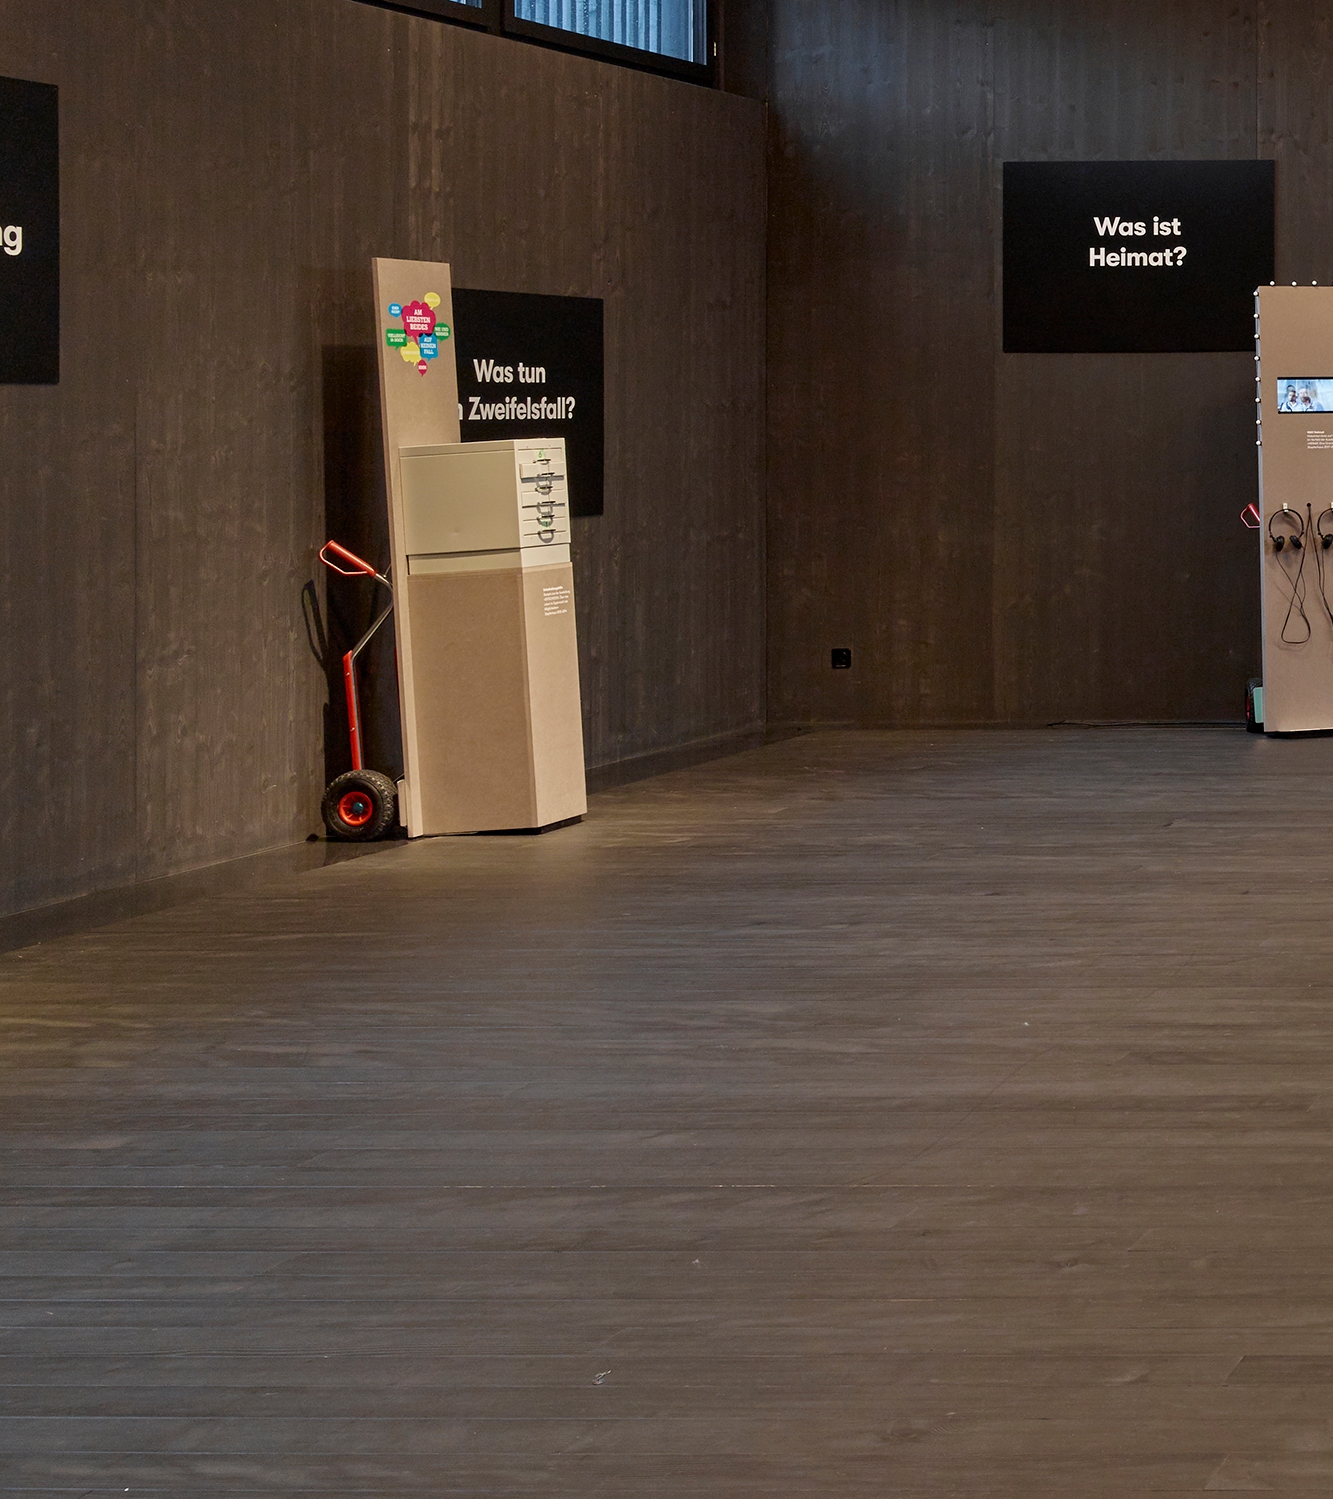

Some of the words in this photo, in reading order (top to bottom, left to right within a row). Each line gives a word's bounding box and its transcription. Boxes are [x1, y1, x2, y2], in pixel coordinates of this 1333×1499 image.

[1093, 216, 1147, 237] Was
[1153, 215, 1182, 236] ist
[1089, 246, 1188, 267] Heimat?
[472, 358, 514, 384] Was
[517, 362, 546, 384] tun
[468, 396, 576, 421] Zweifelsfall?
